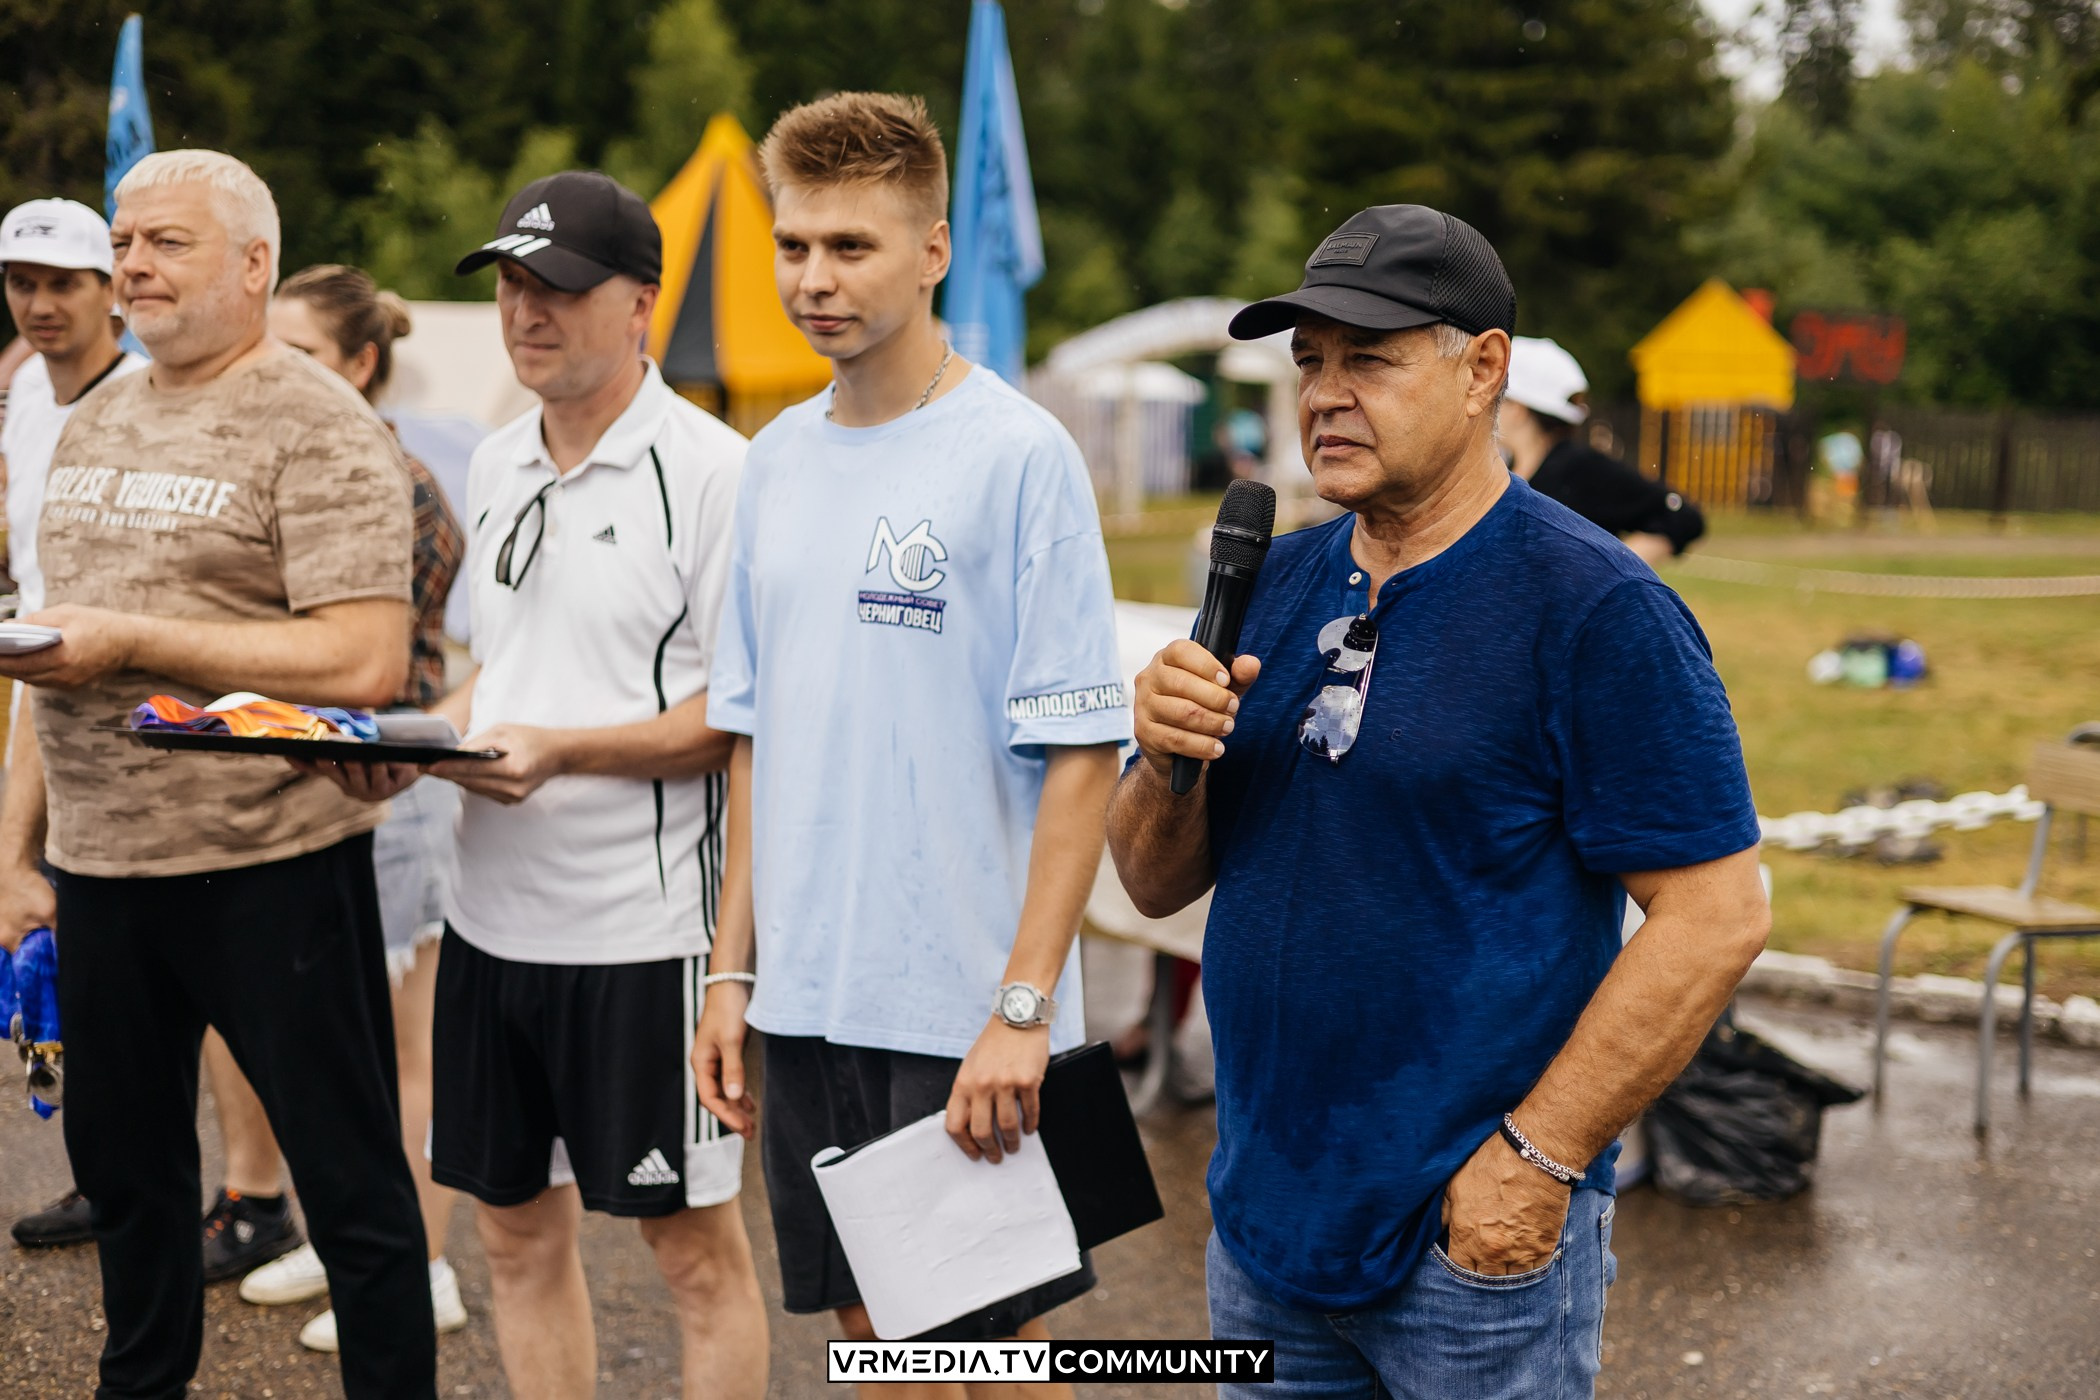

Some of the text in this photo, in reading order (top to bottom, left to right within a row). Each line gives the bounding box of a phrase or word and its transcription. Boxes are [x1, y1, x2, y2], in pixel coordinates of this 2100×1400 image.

[115, 470, 237, 518] YOURSELF
[858, 602, 942, 634] ЧЕРНИГОВЕЦ
[627, 1169, 680, 1186] adidas
